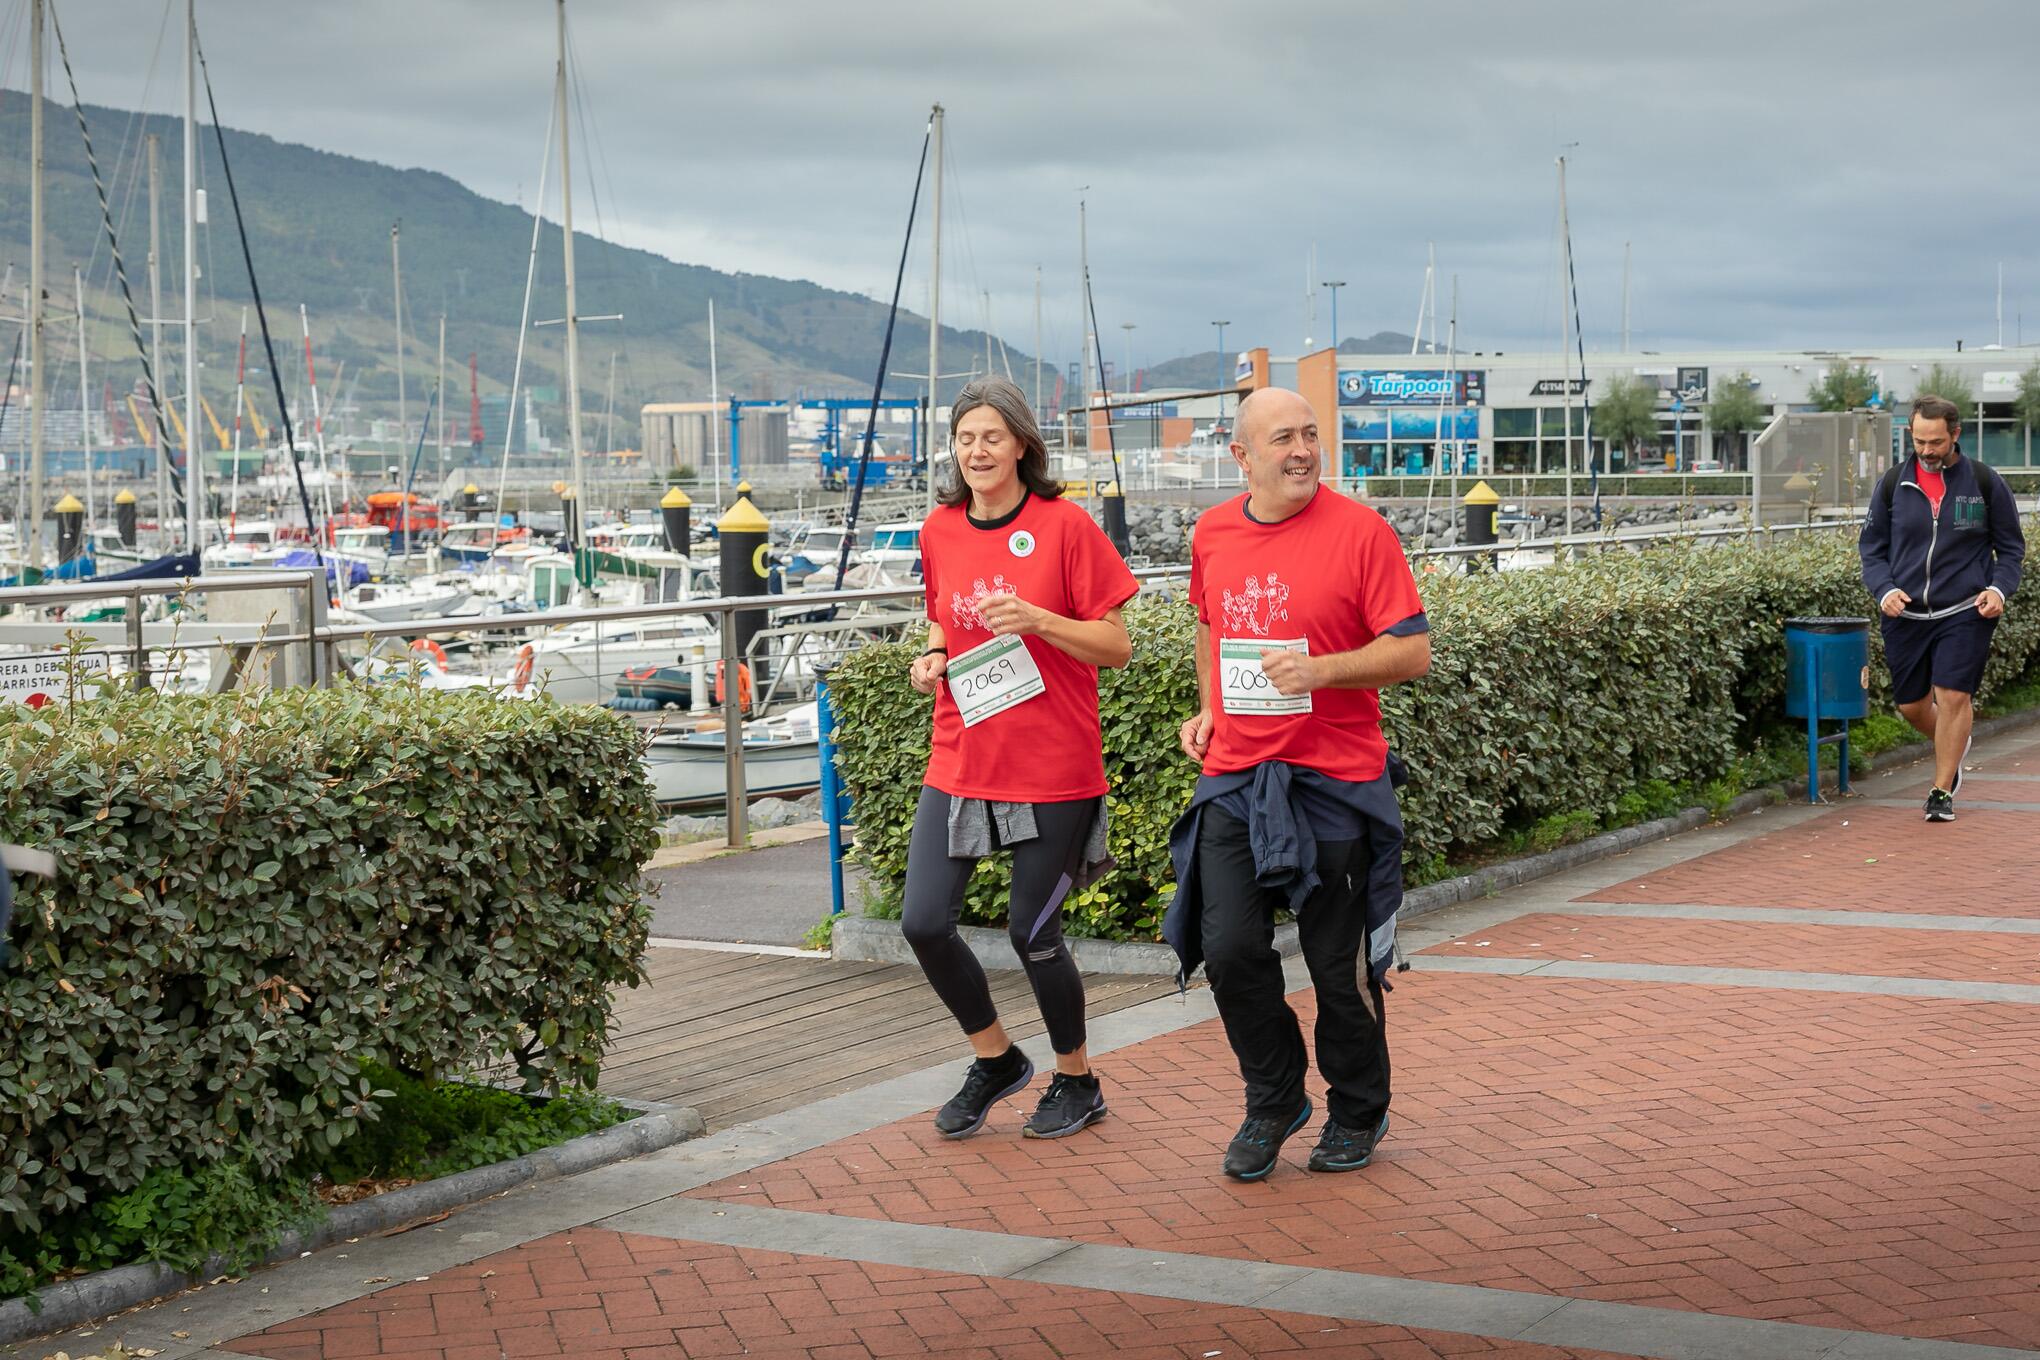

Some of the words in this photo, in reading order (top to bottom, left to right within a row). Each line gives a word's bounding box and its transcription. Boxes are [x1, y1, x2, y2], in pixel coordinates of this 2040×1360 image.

[1369, 376, 1454, 398] Tarpoon
[961, 658, 1016, 698] 2069
[1228, 666, 1268, 691] 206
